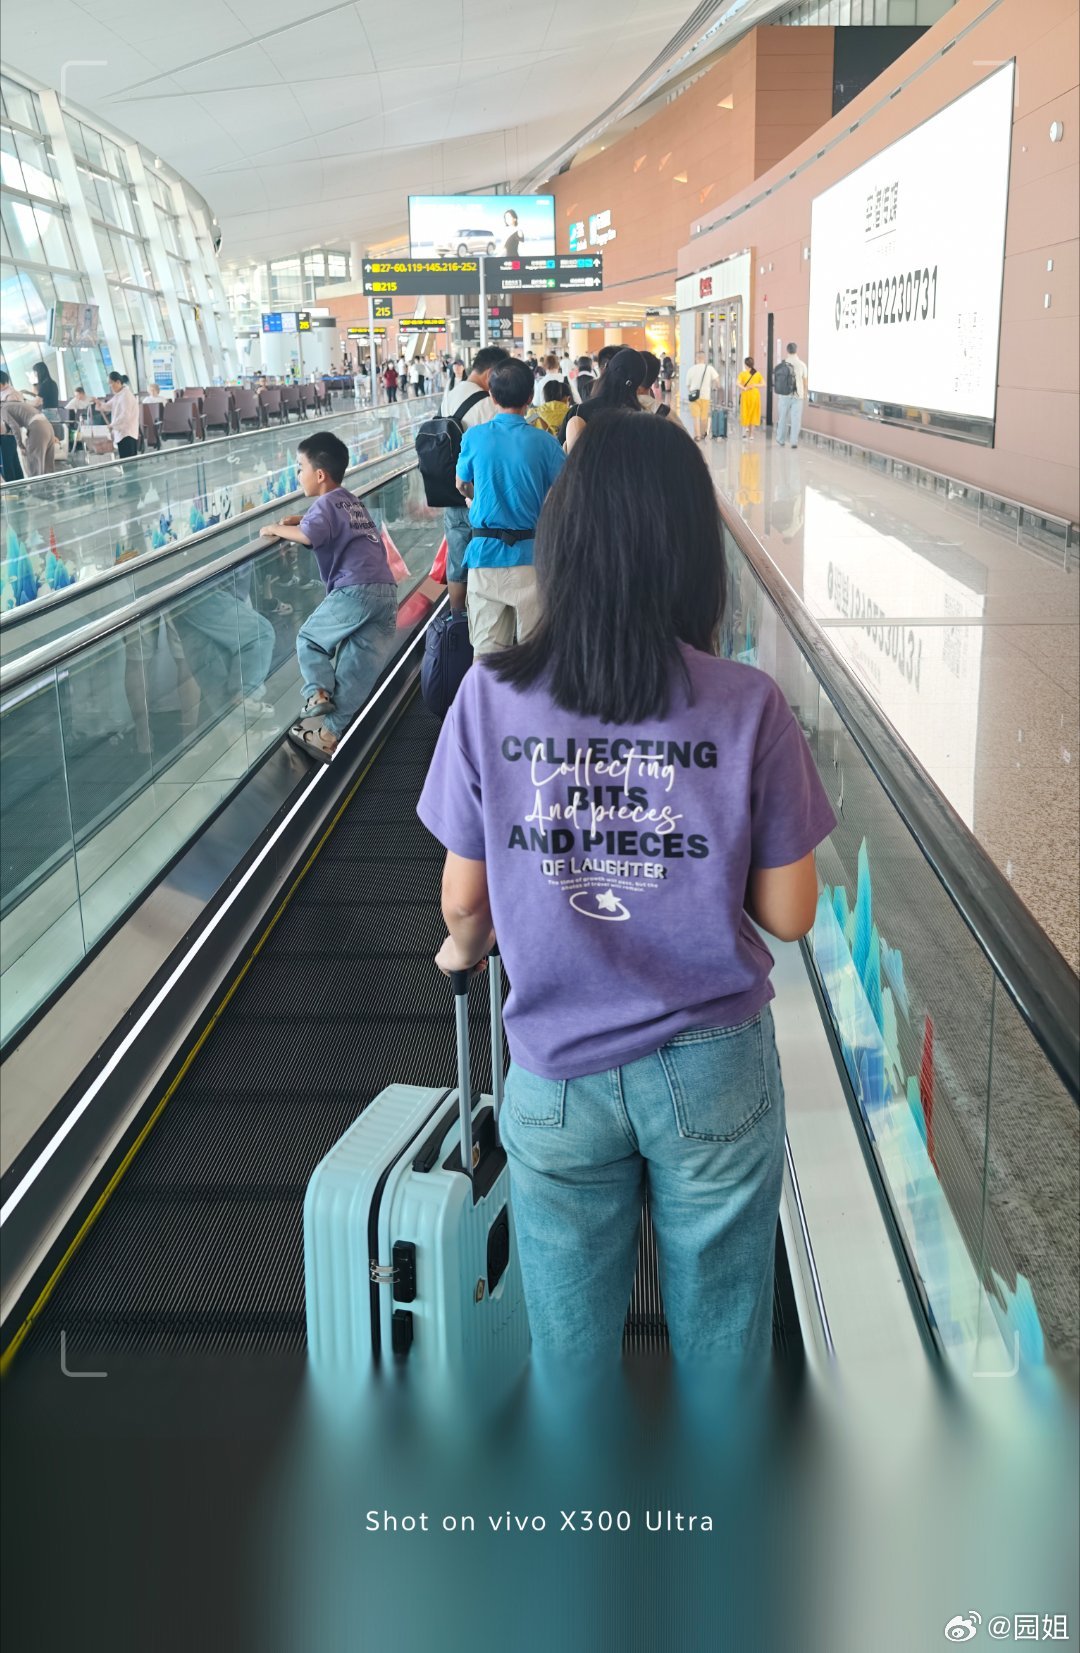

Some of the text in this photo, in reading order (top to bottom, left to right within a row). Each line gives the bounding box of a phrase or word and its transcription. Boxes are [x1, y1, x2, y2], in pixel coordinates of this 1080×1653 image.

[380, 282, 397, 292] 215
[375, 306, 391, 317] 215
[501, 735, 718, 769] COLLECTING
[530, 742, 676, 796] Collecting
[567, 785, 649, 811] BITS
[525, 789, 684, 838] And pieces
[508, 824, 710, 860] AND PIECES
[541, 856, 668, 880] OF LAUGHTER
